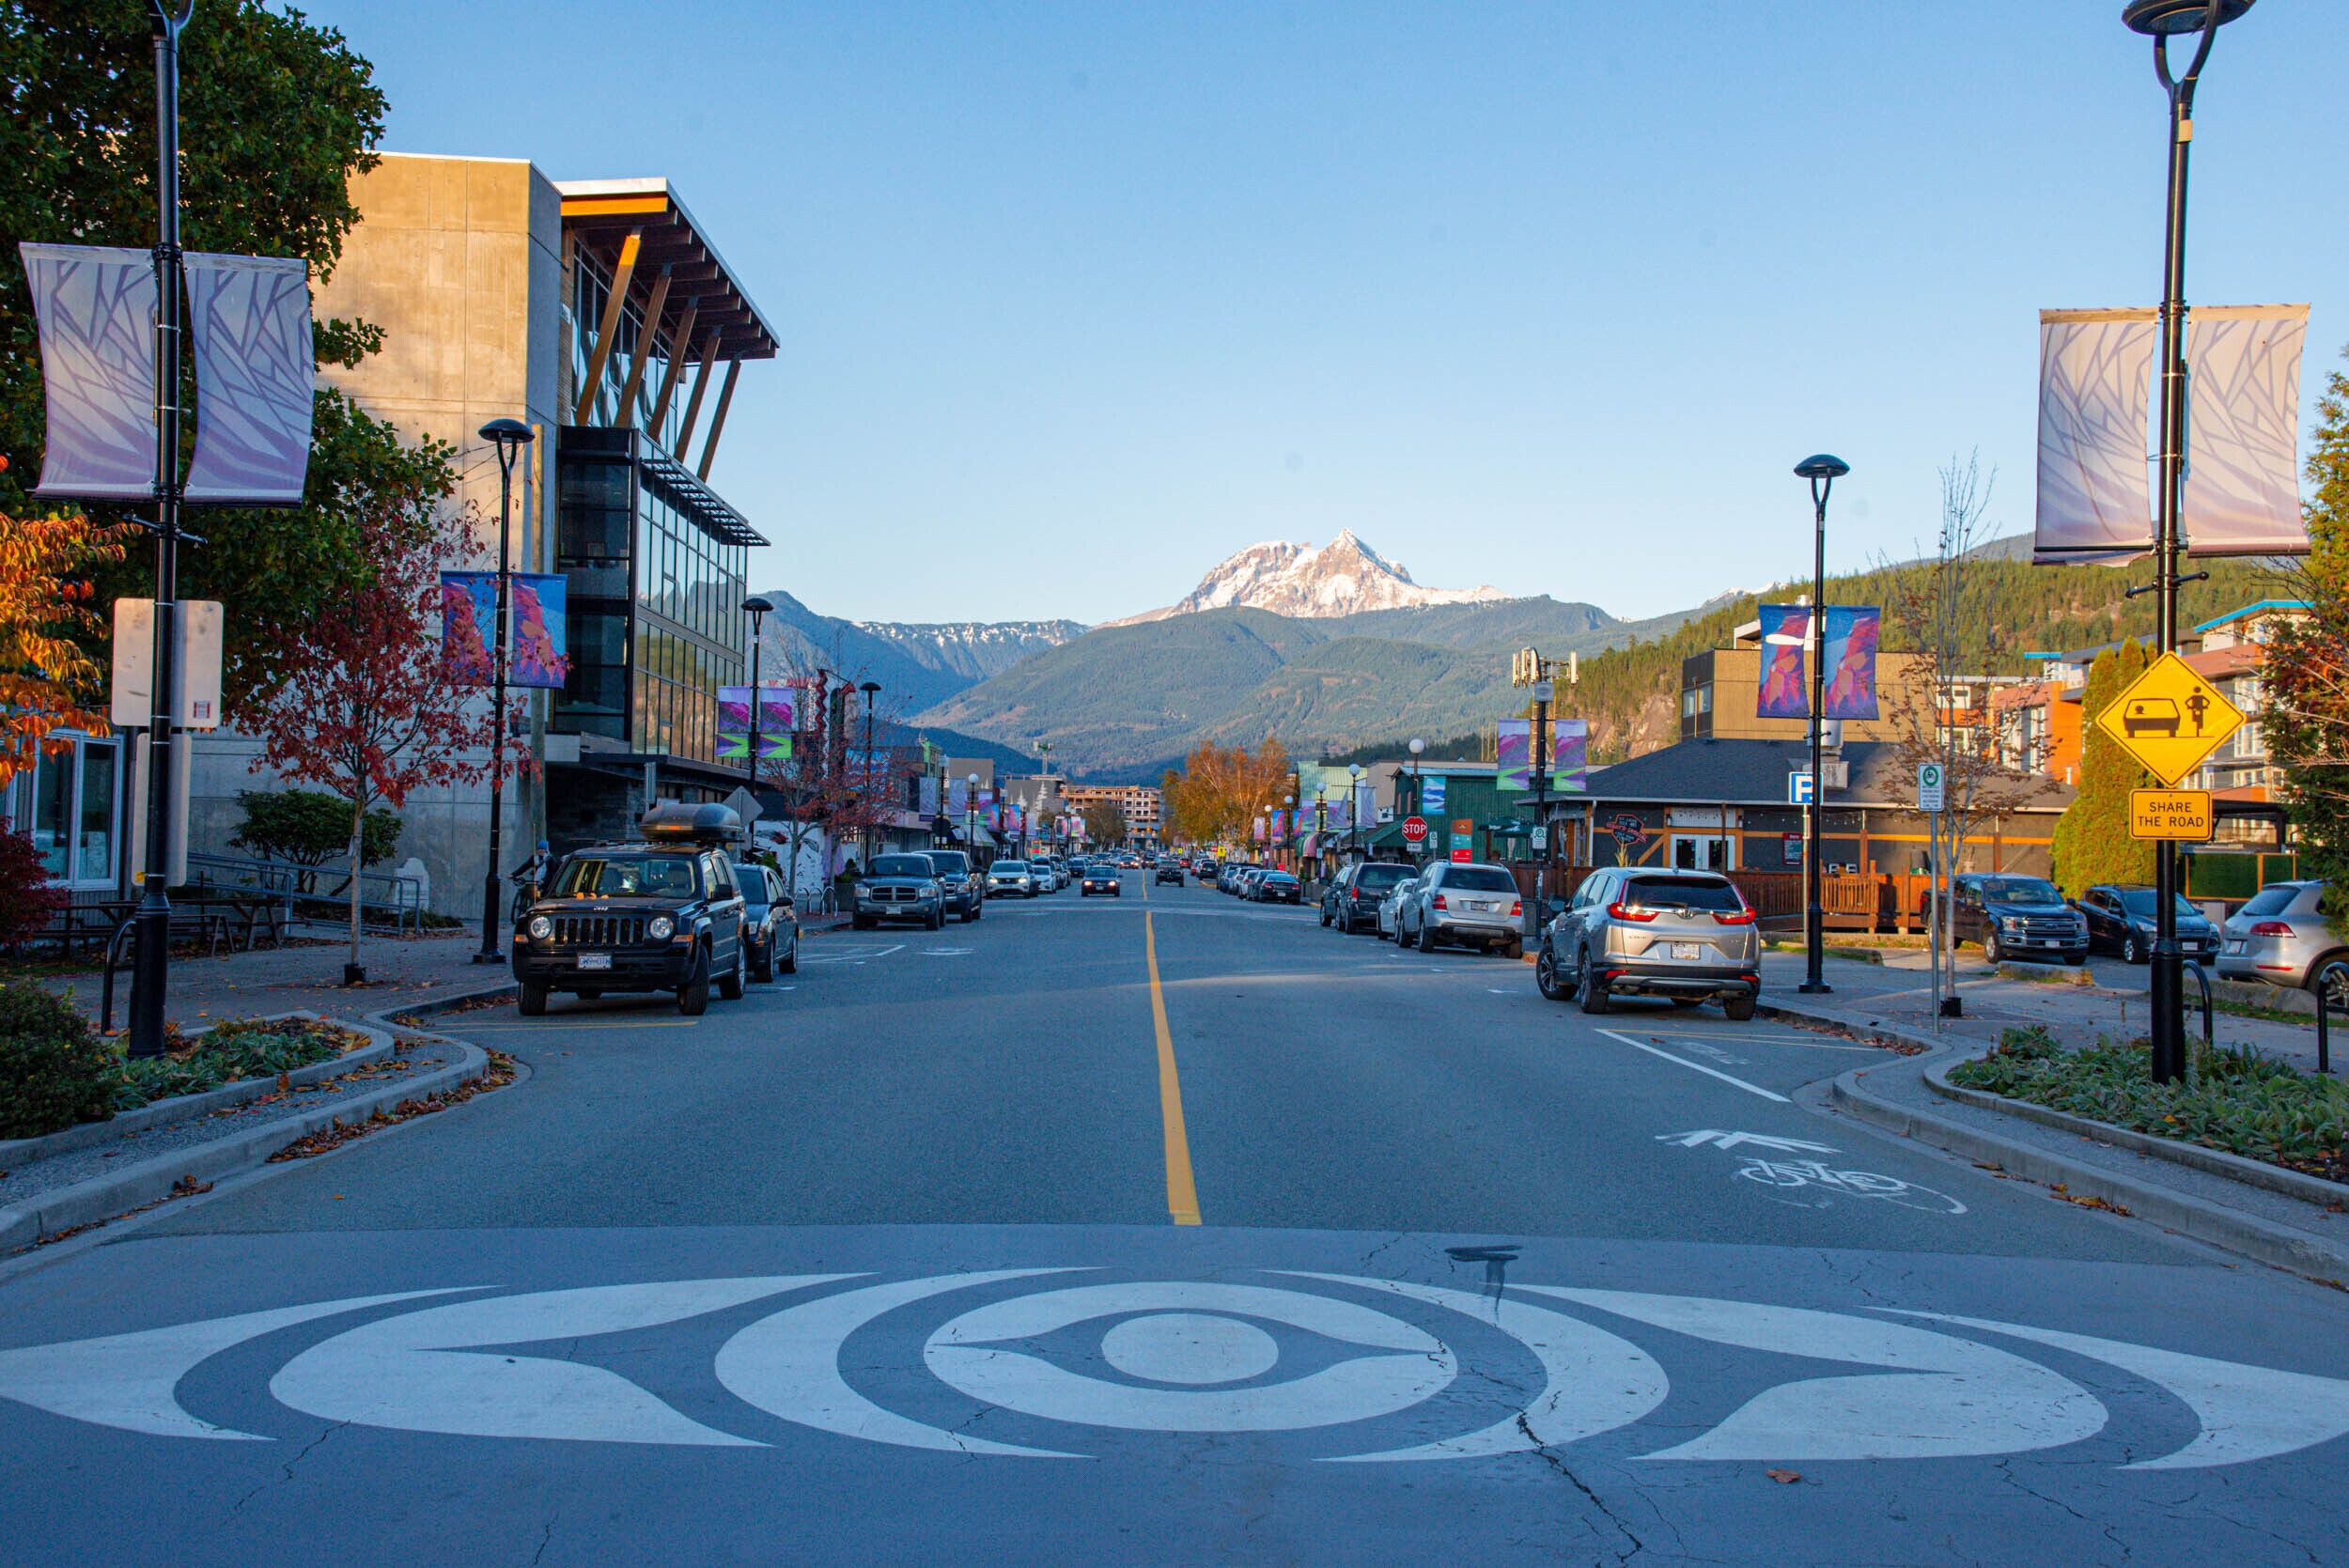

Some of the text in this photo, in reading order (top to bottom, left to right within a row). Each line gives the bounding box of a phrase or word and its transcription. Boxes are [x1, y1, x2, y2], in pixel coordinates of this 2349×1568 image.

[1796, 776, 1813, 801] P
[2149, 801, 2192, 813] SHARE
[2138, 815, 2204, 828] THE ROAD
[1403, 824, 1426, 834] STOP
